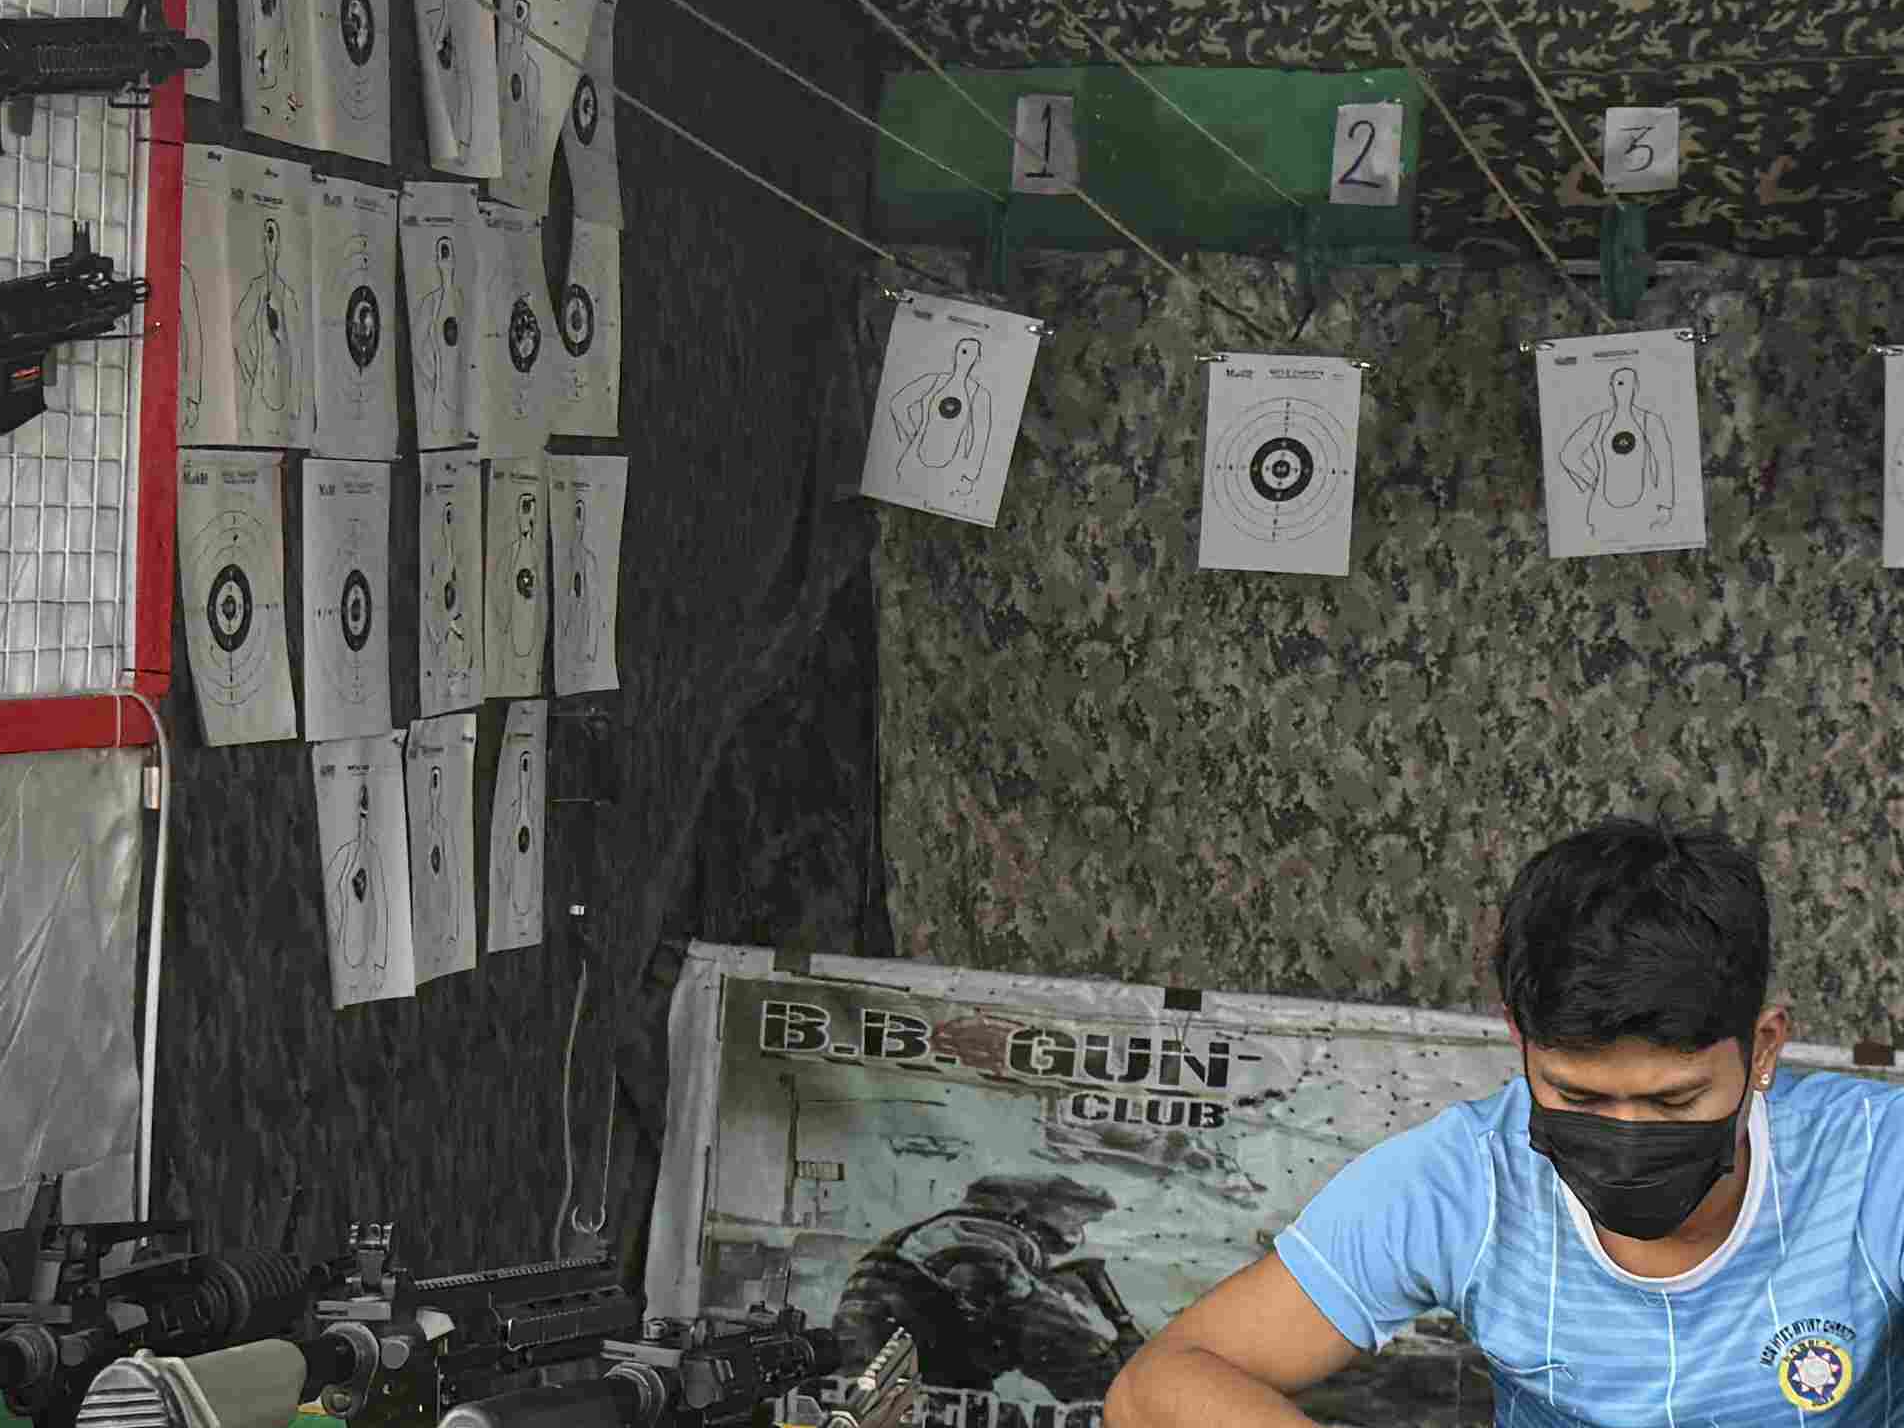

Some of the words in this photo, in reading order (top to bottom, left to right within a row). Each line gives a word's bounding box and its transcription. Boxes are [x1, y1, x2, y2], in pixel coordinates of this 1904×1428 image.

[1025, 103, 1054, 178] 1
[1339, 120, 1382, 189] 2
[1622, 124, 1656, 173] 3
[760, 1000, 958, 1065] B.B.
[1006, 1027, 1229, 1088] GUN
[1070, 1091, 1225, 1129] CLUB
